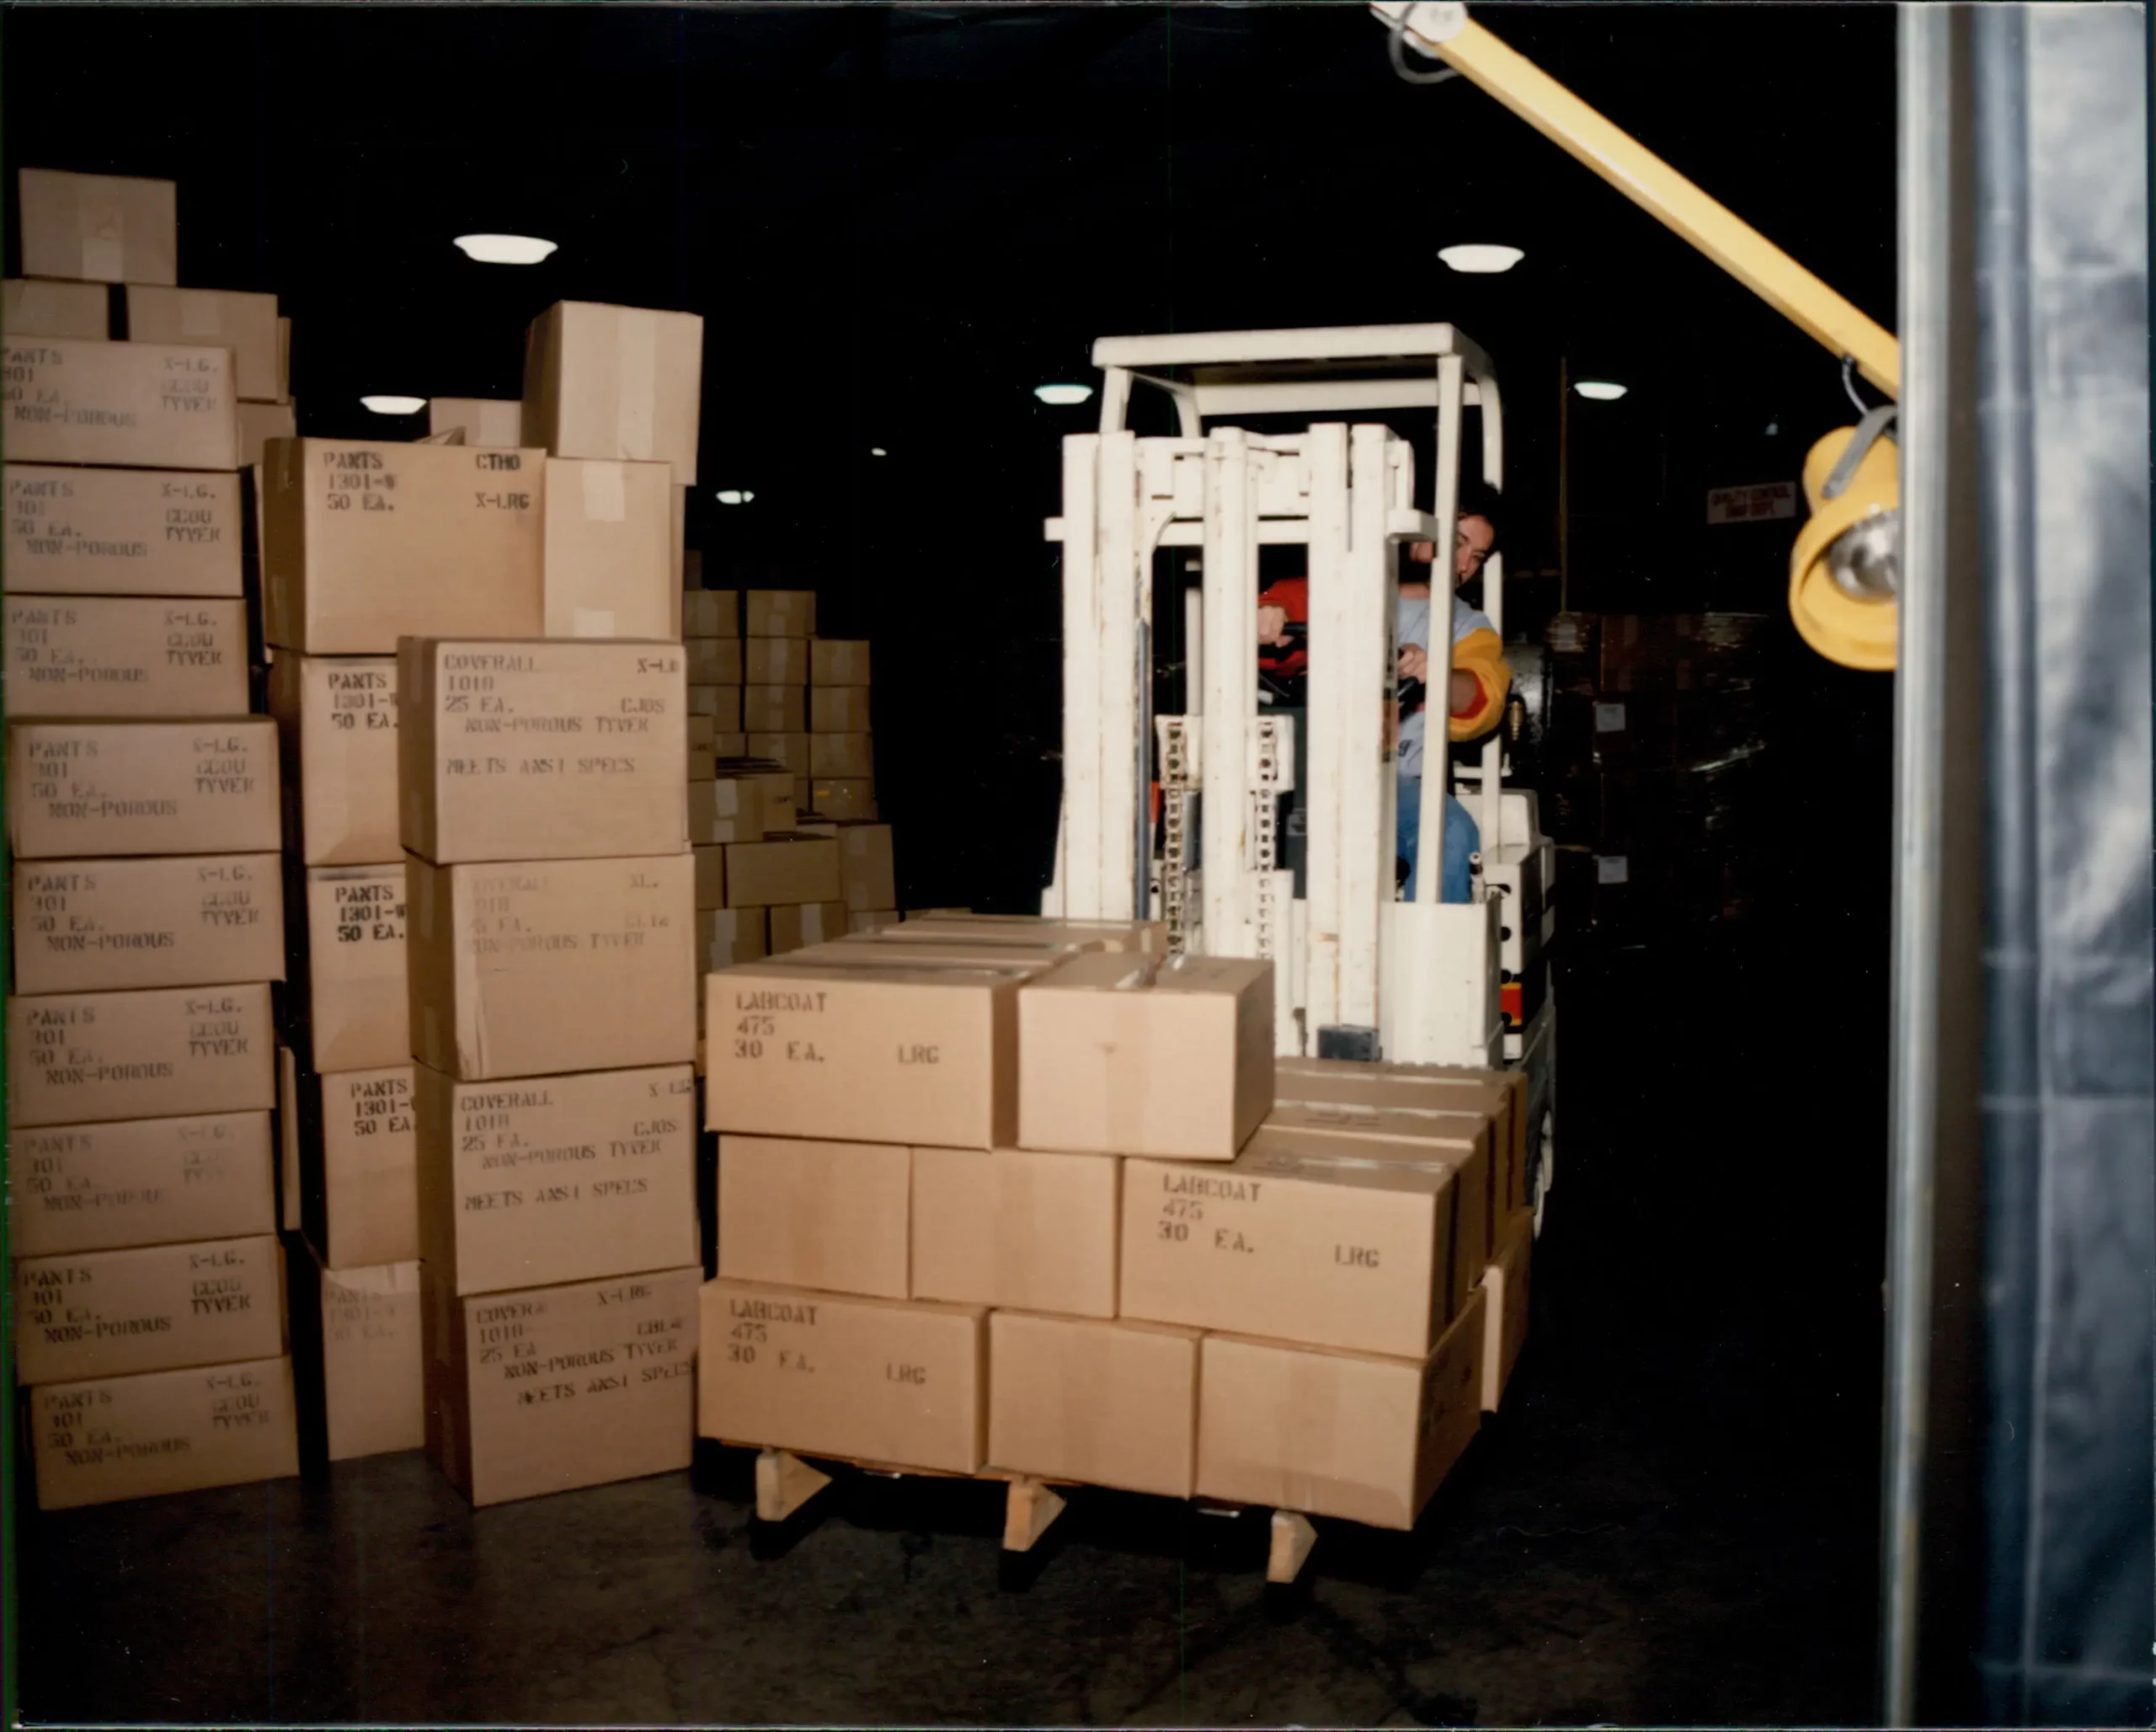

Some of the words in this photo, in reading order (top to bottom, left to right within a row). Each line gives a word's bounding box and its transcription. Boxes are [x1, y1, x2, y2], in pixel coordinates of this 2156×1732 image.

[323, 452, 384, 471] PANTS
[10, 478, 74, 499] PANTS
[326, 493, 351, 511] 50
[360, 493, 396, 512] EA.
[474, 491, 531, 511] X-LRG
[11, 608, 77, 626] PANTS
[444, 654, 541, 672] COVERALL
[327, 671, 387, 690] PANTS
[445, 695, 470, 714] 25
[478, 696, 515, 714] EA.
[330, 712, 355, 730] 50
[465, 716, 583, 734] NON-POROUS
[594, 715, 649, 734] TYVEK
[28, 740, 99, 758] PANTS
[446, 756, 507, 777] MEETS
[578, 756, 636, 774] SPECS
[27, 874, 97, 893] PANTS
[334, 885, 395, 904] PANTS
[336, 924, 362, 943] 50
[371, 922, 405, 941] EA.
[734, 991, 826, 1013] LABCOAT
[26, 1008, 96, 1028] PANTS
[736, 1015, 776, 1035] 475
[734, 1038, 764, 1060] 30
[785, 1040, 825, 1063] EA.
[896, 1042, 941, 1065] LRG
[350, 1078, 408, 1099] PANTS
[460, 1090, 554, 1112] COVERALL
[353, 1118, 377, 1137] 50
[24, 1133, 92, 1154] PANTS
[462, 1134, 486, 1152] 25
[496, 1132, 530, 1148] EA.
[482, 1143, 597, 1170] NON-POROUS
[608, 1137, 663, 1159] TYVEK
[464, 1189, 524, 1211] MEETS
[592, 1178, 648, 1200] SPECS
[1161, 1173, 1262, 1202] LABCOAT
[1161, 1198, 1204, 1221] 475
[1156, 1220, 1190, 1243] 30
[1214, 1227, 1255, 1254] EA.
[1333, 1243, 1382, 1270] LRG
[24, 1267, 92, 1287] PANTS
[729, 1298, 818, 1327] LABCOAT
[729, 1322, 768, 1343] 475
[478, 1346, 504, 1365] 25
[504, 1348, 616, 1380] NON-POROUS
[727, 1342, 756, 1365] 30
[777, 1350, 816, 1374] EA.
[884, 1360, 927, 1387] LRG
[43, 1389, 113, 1410] PANTS
